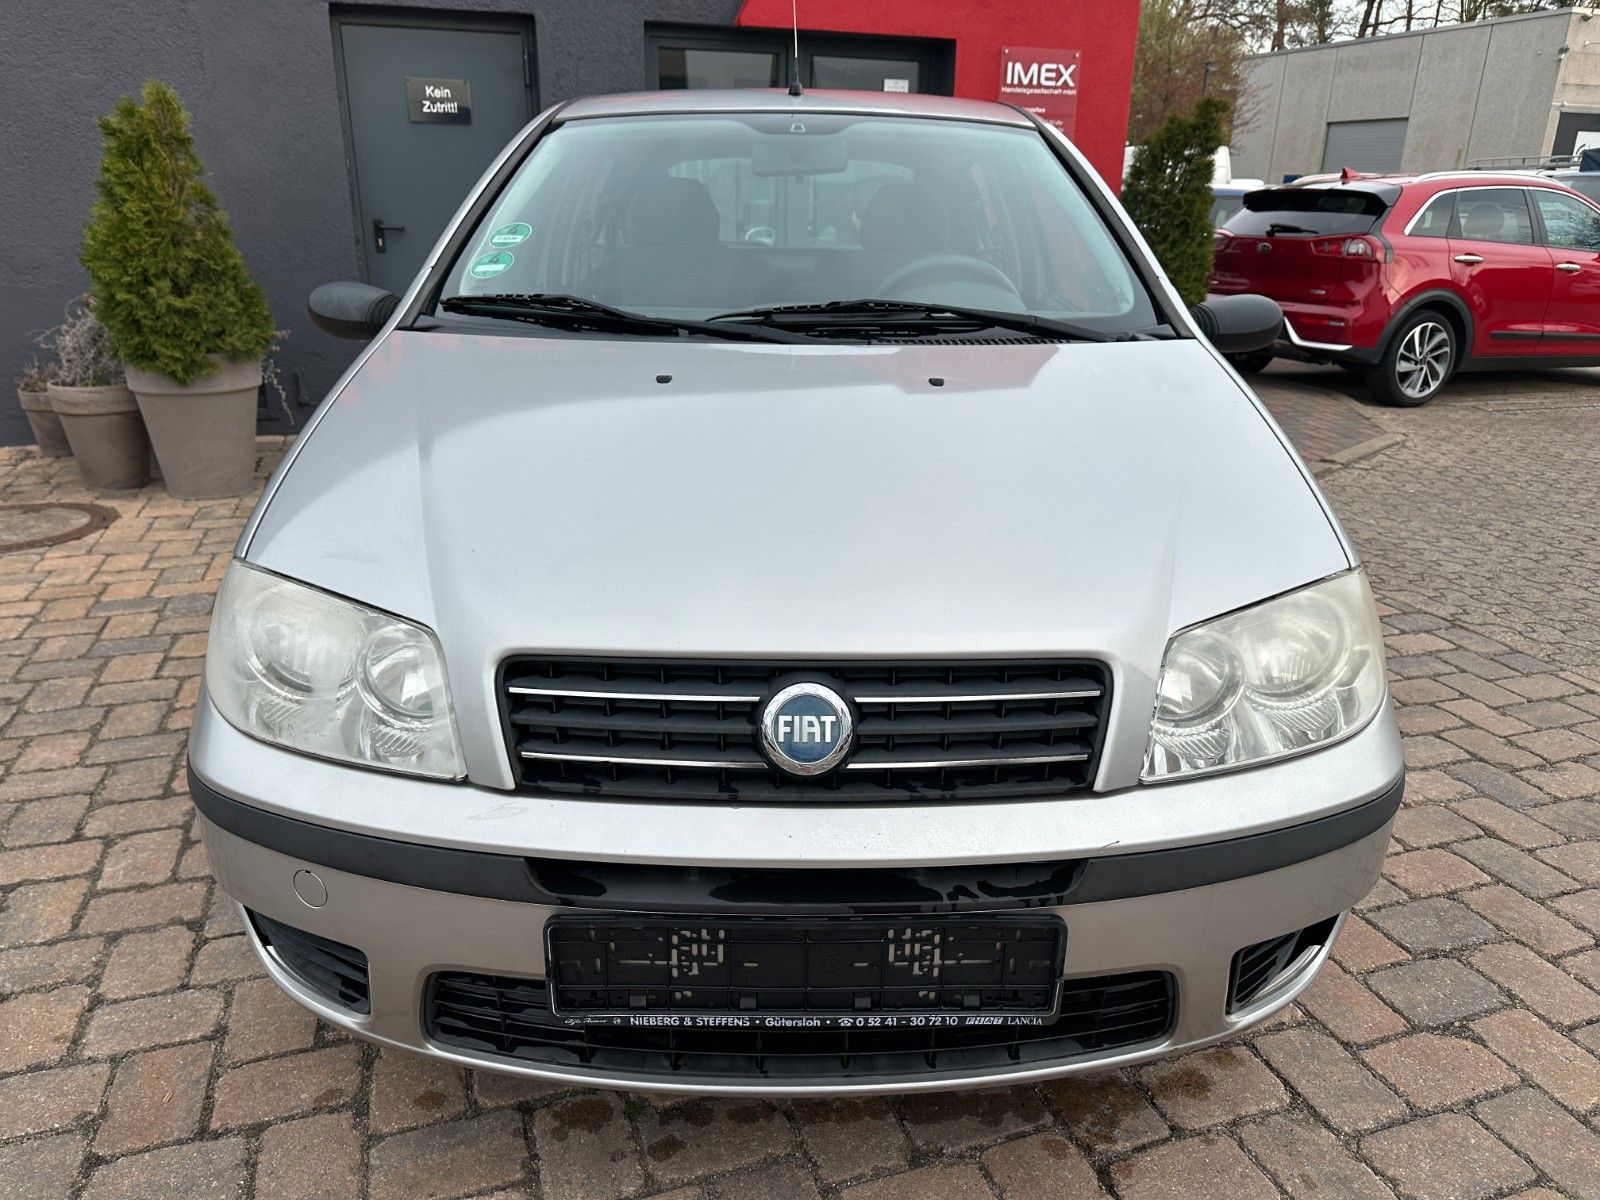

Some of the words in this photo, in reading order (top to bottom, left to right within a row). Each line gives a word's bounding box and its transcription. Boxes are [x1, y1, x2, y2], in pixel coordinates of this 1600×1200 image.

[1006, 61, 1076, 87] IMEX
[425, 85, 451, 98] Kein
[778, 715, 837, 743] FIAT
[630, 1016, 680, 1026] NIEBERG
[683, 1016, 693, 1026] &
[696, 1016, 750, 1027] STEFFENS
[765, 1017, 821, 1027] Gütersloh
[855, 1017, 865, 1027] 0
[867, 1017, 881, 1027] 52
[884, 1017, 897, 1026] 41
[909, 1016, 926, 1026] 30
[928, 1016, 942, 1026] 72
[945, 1016, 959, 1026] 10
[1007, 1016, 1043, 1026] LANCIA
